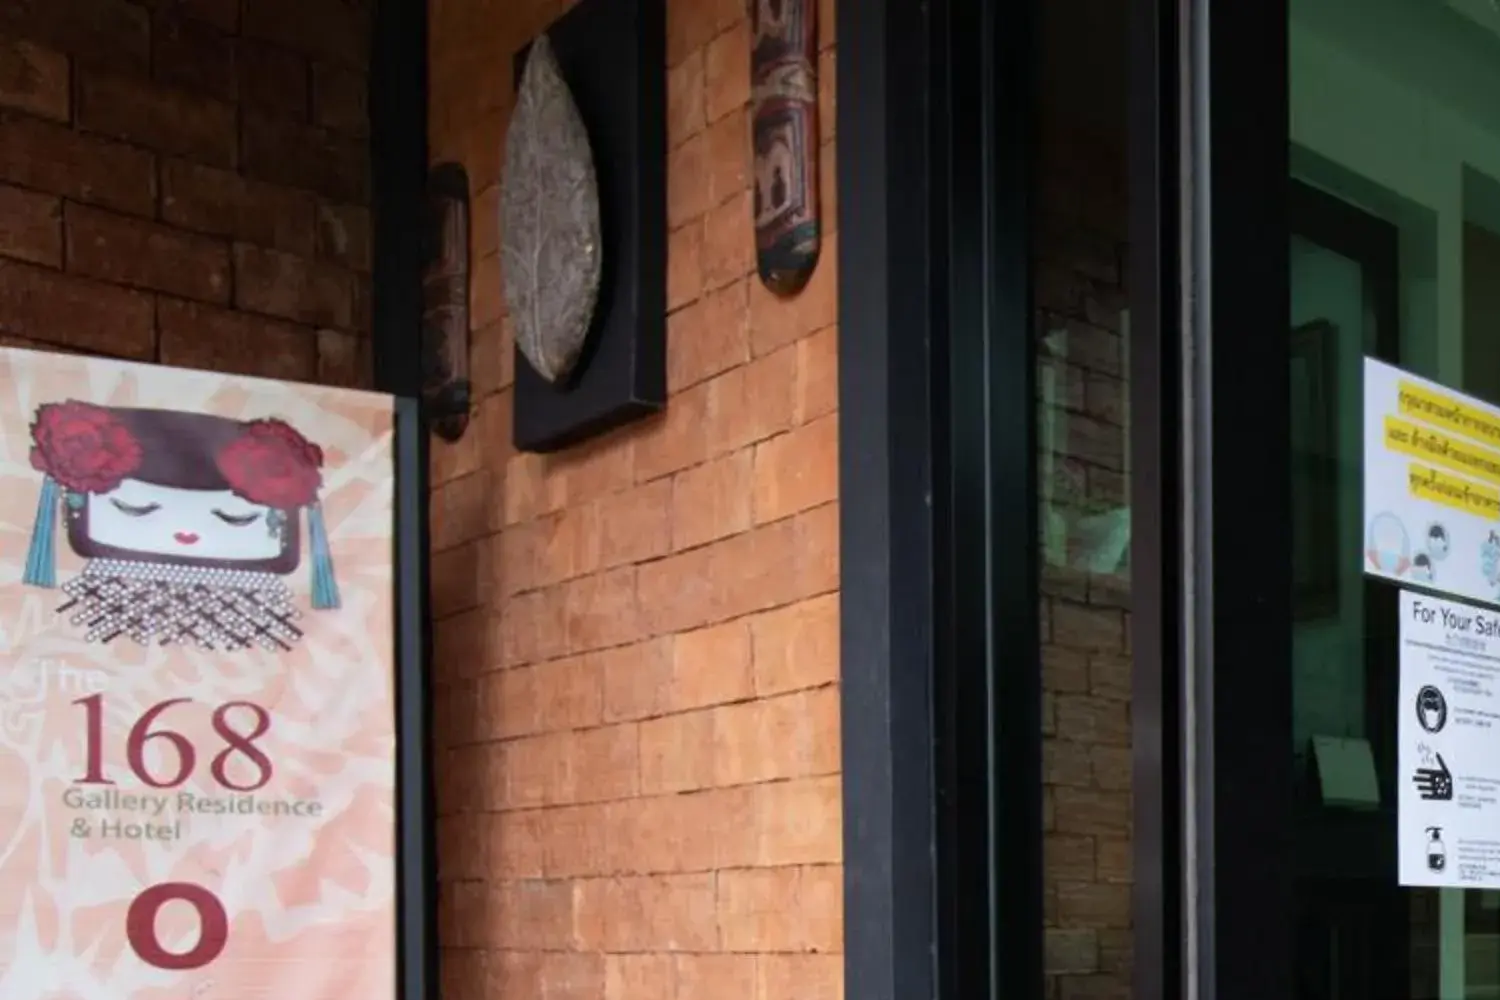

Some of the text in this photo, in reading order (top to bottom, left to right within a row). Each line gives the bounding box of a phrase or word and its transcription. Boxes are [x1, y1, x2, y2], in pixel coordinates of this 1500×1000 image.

[1412, 601, 1436, 623] For
[1441, 607, 1472, 631] Your
[72, 692, 272, 792] 168
[62, 788, 323, 818] Gallery Residence
[70, 818, 182, 841] & Hotel
